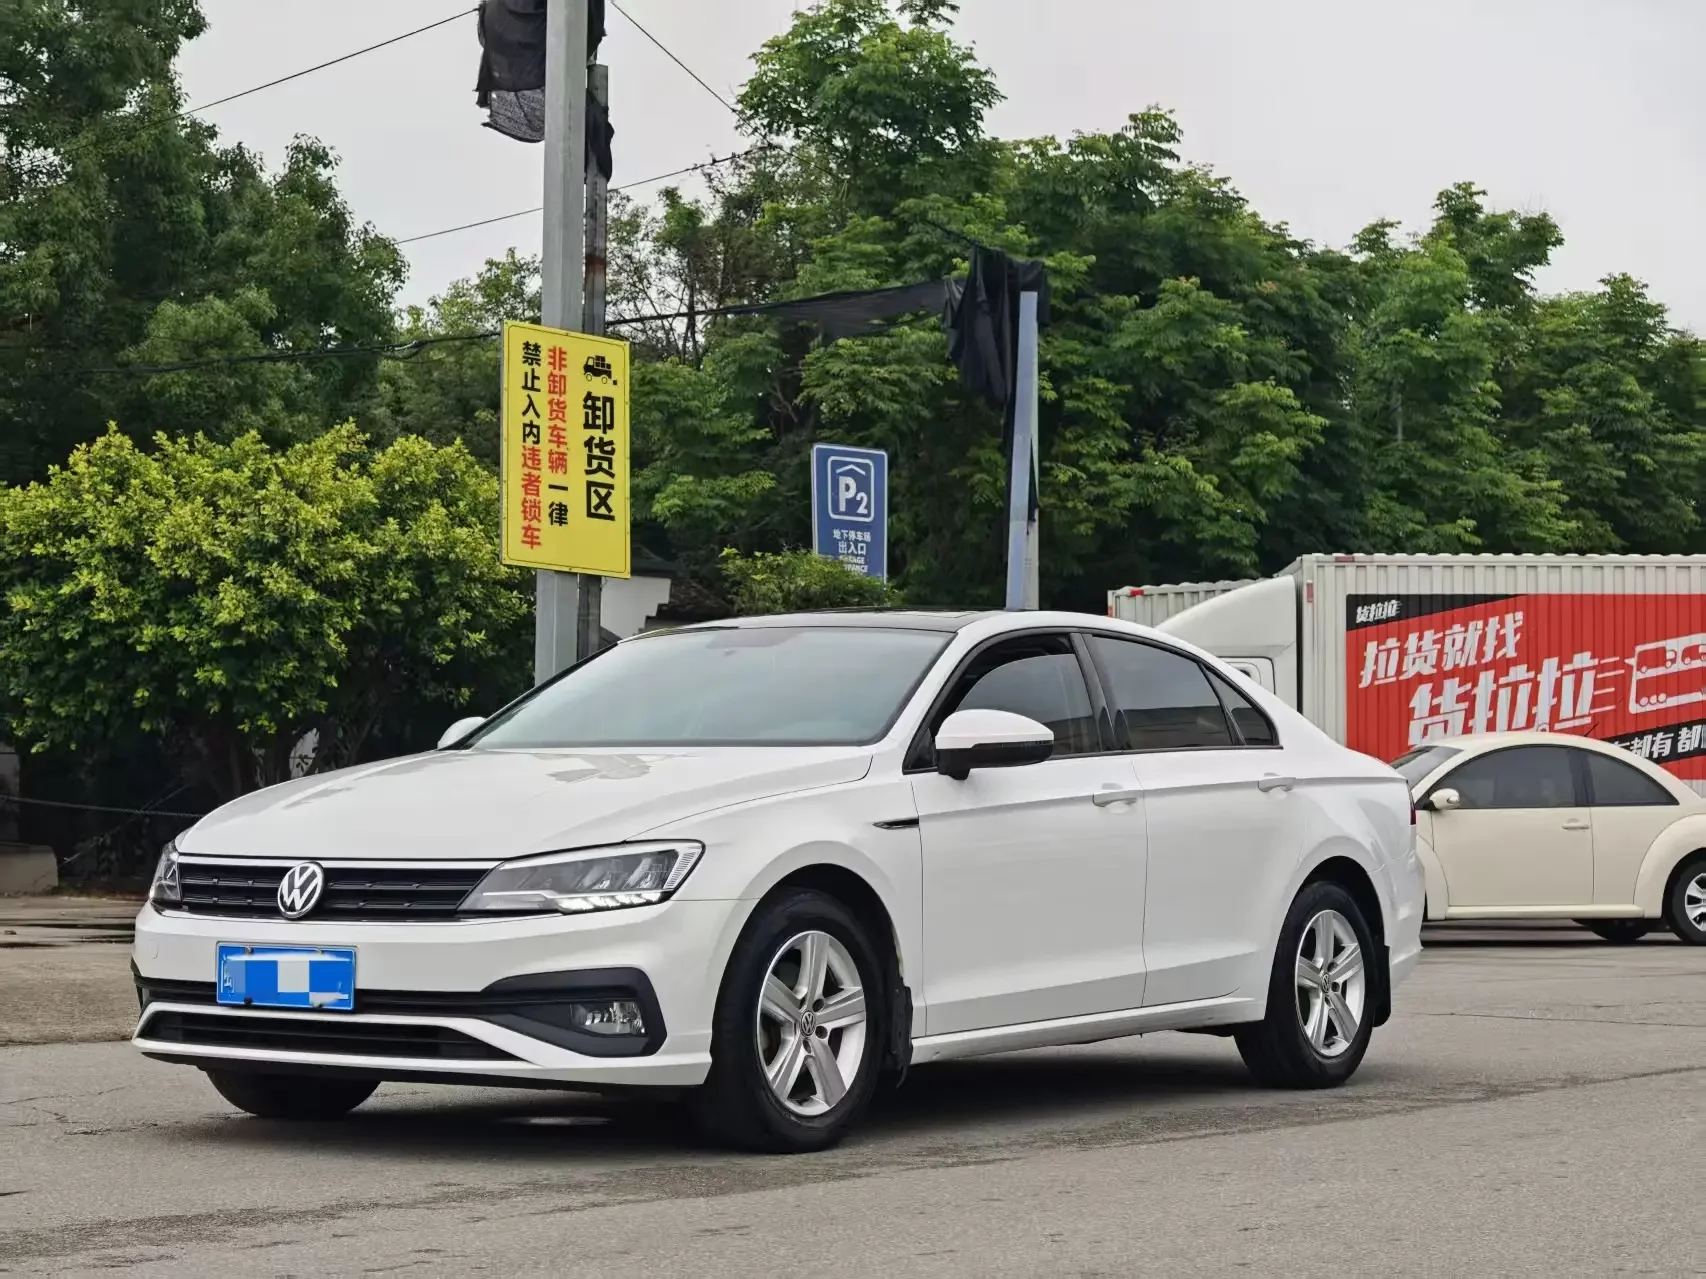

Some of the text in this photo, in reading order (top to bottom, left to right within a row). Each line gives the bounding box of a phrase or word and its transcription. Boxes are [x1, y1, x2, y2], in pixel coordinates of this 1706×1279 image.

[520, 340, 542, 550] 禁止入内违者锁车
[547, 345, 569, 527] 非卸货车辆一律
[582, 391, 616, 522] 卸货区
[838, 541, 867, 556] 出入口
[1358, 610, 1524, 689] 拉货就找
[1408, 651, 1600, 746] 货拉拉
[1677, 724, 1706, 753] 都
